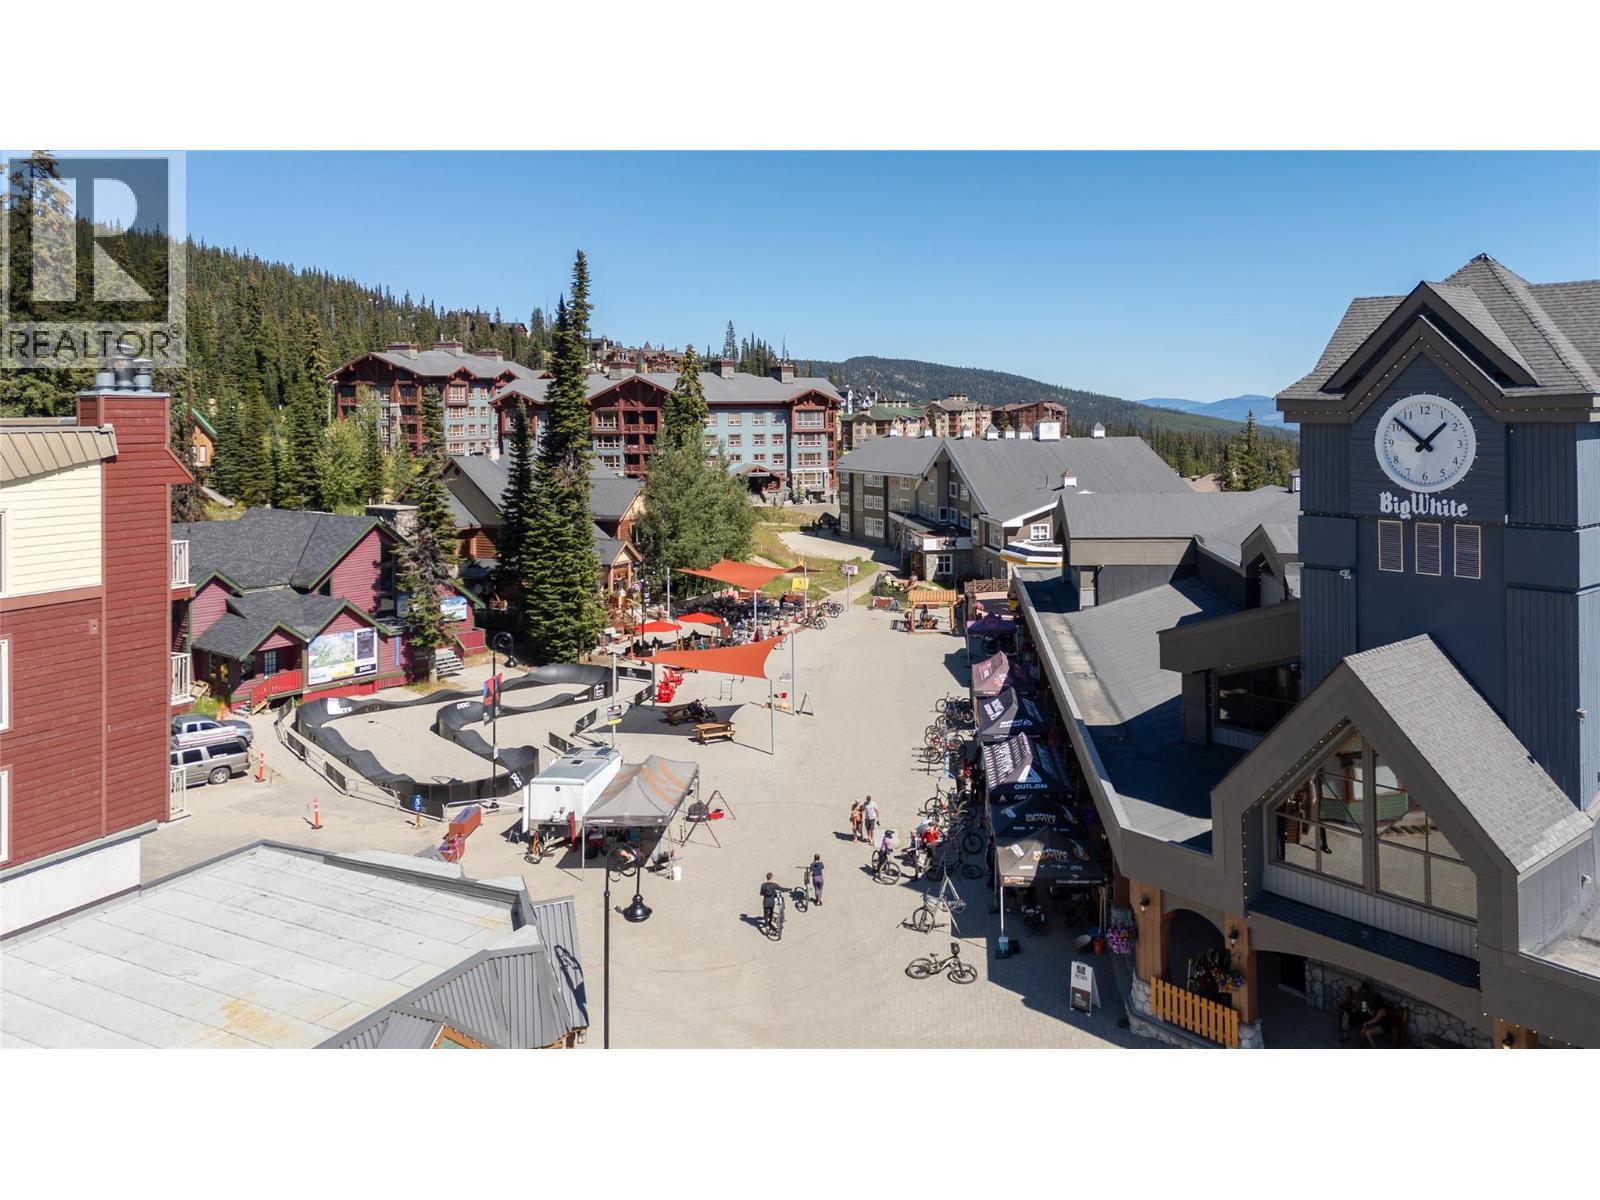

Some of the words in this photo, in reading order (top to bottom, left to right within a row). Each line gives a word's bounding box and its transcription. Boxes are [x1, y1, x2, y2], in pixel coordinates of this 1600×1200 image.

[1420, 405, 1431, 415] 12
[1404, 411, 1413, 420] 11
[1392, 422, 1403, 432] 10
[1452, 422, 1458, 432] 2
[1389, 439, 1394, 448] 9
[1457, 439, 1463, 449] 3
[1393, 455, 1399, 464] 8
[1452, 456, 1458, 466] 4
[1405, 467, 1411, 476] 7
[1422, 472, 1428, 481] 6
[1440, 468, 1446, 478] 5
